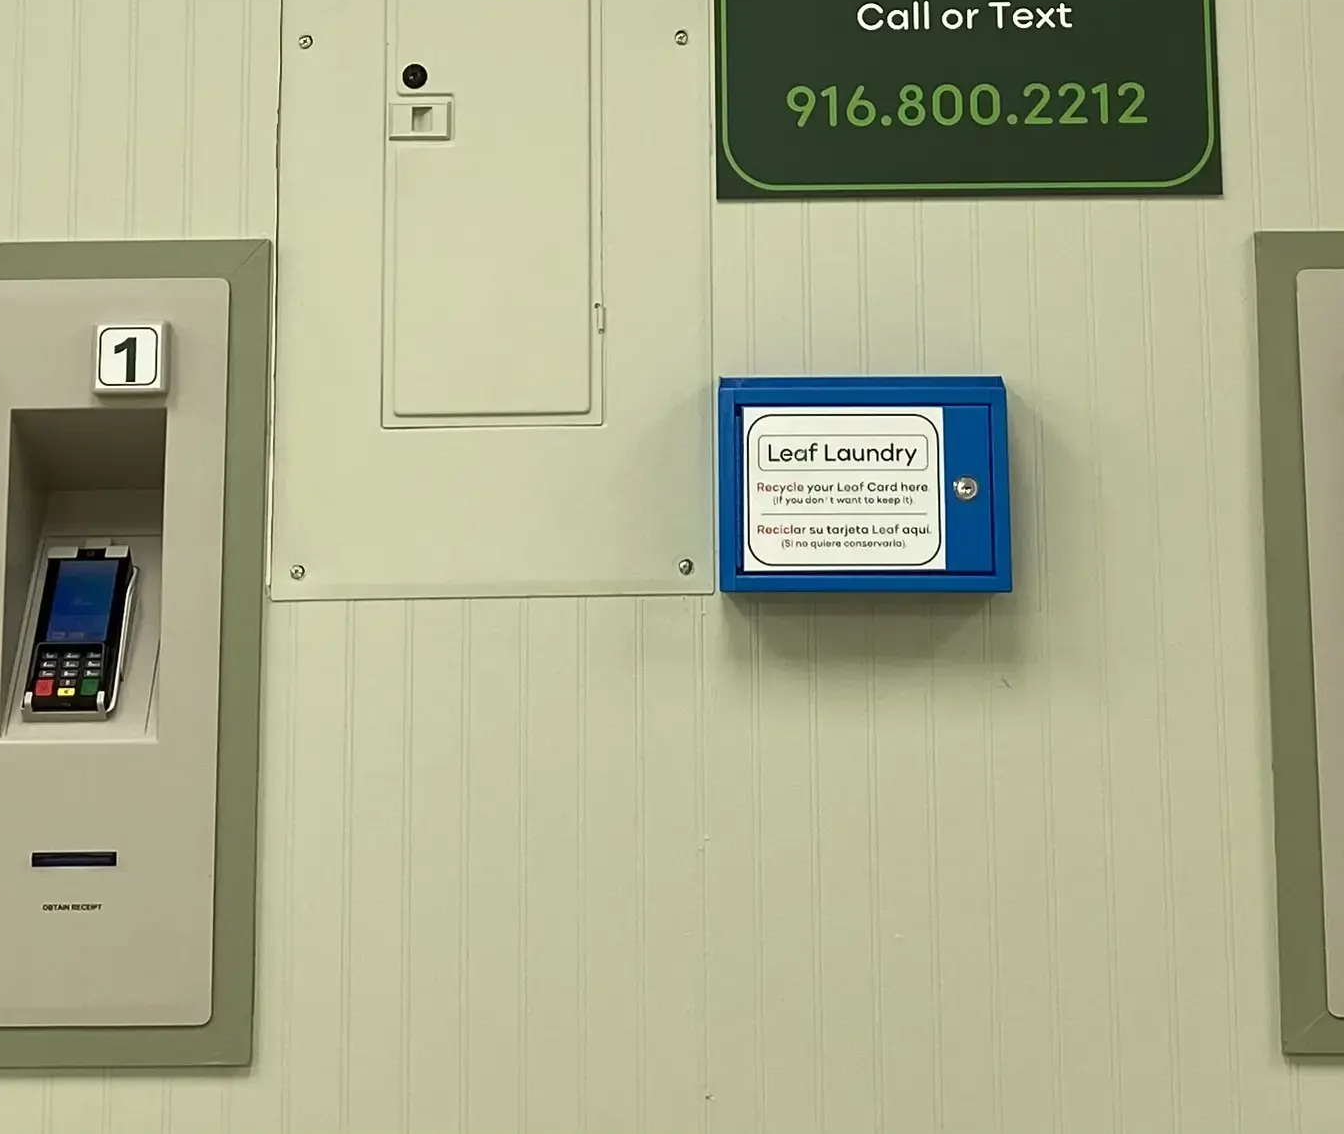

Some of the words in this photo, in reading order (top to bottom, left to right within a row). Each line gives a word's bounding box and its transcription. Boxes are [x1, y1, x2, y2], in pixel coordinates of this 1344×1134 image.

[856, 0, 929, 31] Call
[941, 8, 978, 30] or
[988, 1, 1073, 29] Text
[786, 81, 1148, 128] 916.800.2212
[114, 336, 139, 383] 1
[768, 443, 819, 462] Leaf
[824, 442, 917, 467] Laundry
[757, 482, 804, 494] Recycle
[807, 484, 834, 494] your
[837, 481, 864, 492] Leaf
[867, 482, 898, 492] Card
[786, 497, 803, 506] you
[877, 496, 901, 506] keep
[757, 524, 806, 535] Reciclar
[809, 527, 823, 535] su
[826, 525, 869, 537] tarjeta
[872, 524, 899, 535] Leaf
[42, 903, 70, 911] OBTAIN
[71, 903, 102, 911] RECEIPT
